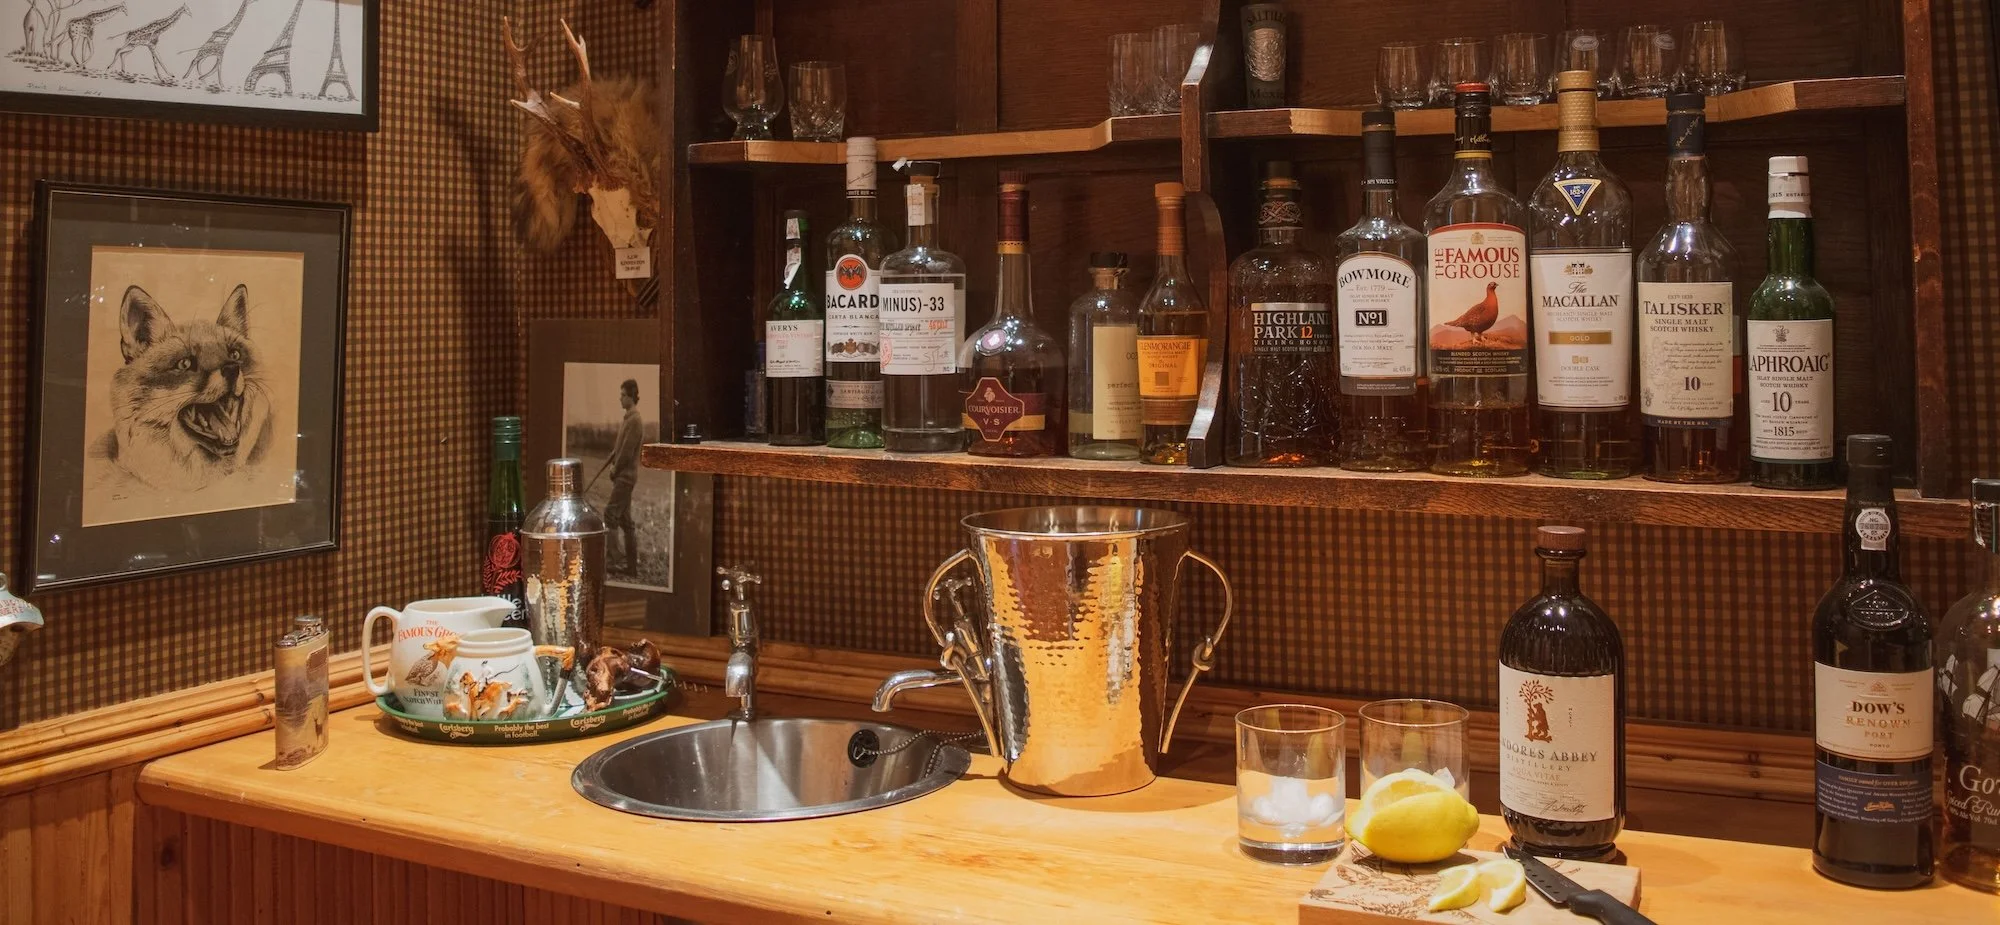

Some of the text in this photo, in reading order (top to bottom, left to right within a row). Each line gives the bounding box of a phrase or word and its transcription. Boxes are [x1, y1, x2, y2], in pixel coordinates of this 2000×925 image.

[1445, 247, 1520, 263] FAMOUS
[1434, 248, 1444, 279] THE
[1445, 263, 1520, 279] GROUSE
[1338, 268, 1412, 289] BOWMORE
[1568, 282, 1588, 294] The
[1542, 295, 1620, 307] MACALLAN
[1644, 301, 1724, 315] TALISKER
[771, 324, 798, 332] AVERYS
[1253, 326, 1298, 340] PARK
[1301, 326, 1313, 338] 12
[1749, 355, 1829, 373] APHROAIG
[1684, 376, 1701, 391] 10
[1773, 391, 1792, 412] 10
[968, 405, 1020, 415] COURVOISIER
[1774, 426, 1795, 436] 1815
[399, 627, 433, 642] FAMOUS
[413, 688, 439, 697] FINEST
[1852, 702, 1905, 714] DOW'S
[494, 724, 523, 732] Probably
[570, 715, 606, 729] Carlsberg
[1846, 716, 1911, 729] RENOWN
[439, 723, 474, 736] Carlsberg
[1864, 731, 1895, 740] PORT
[1506, 754, 1572, 771] DISTILLERY
[1550, 751, 1598, 762] ABBEY
